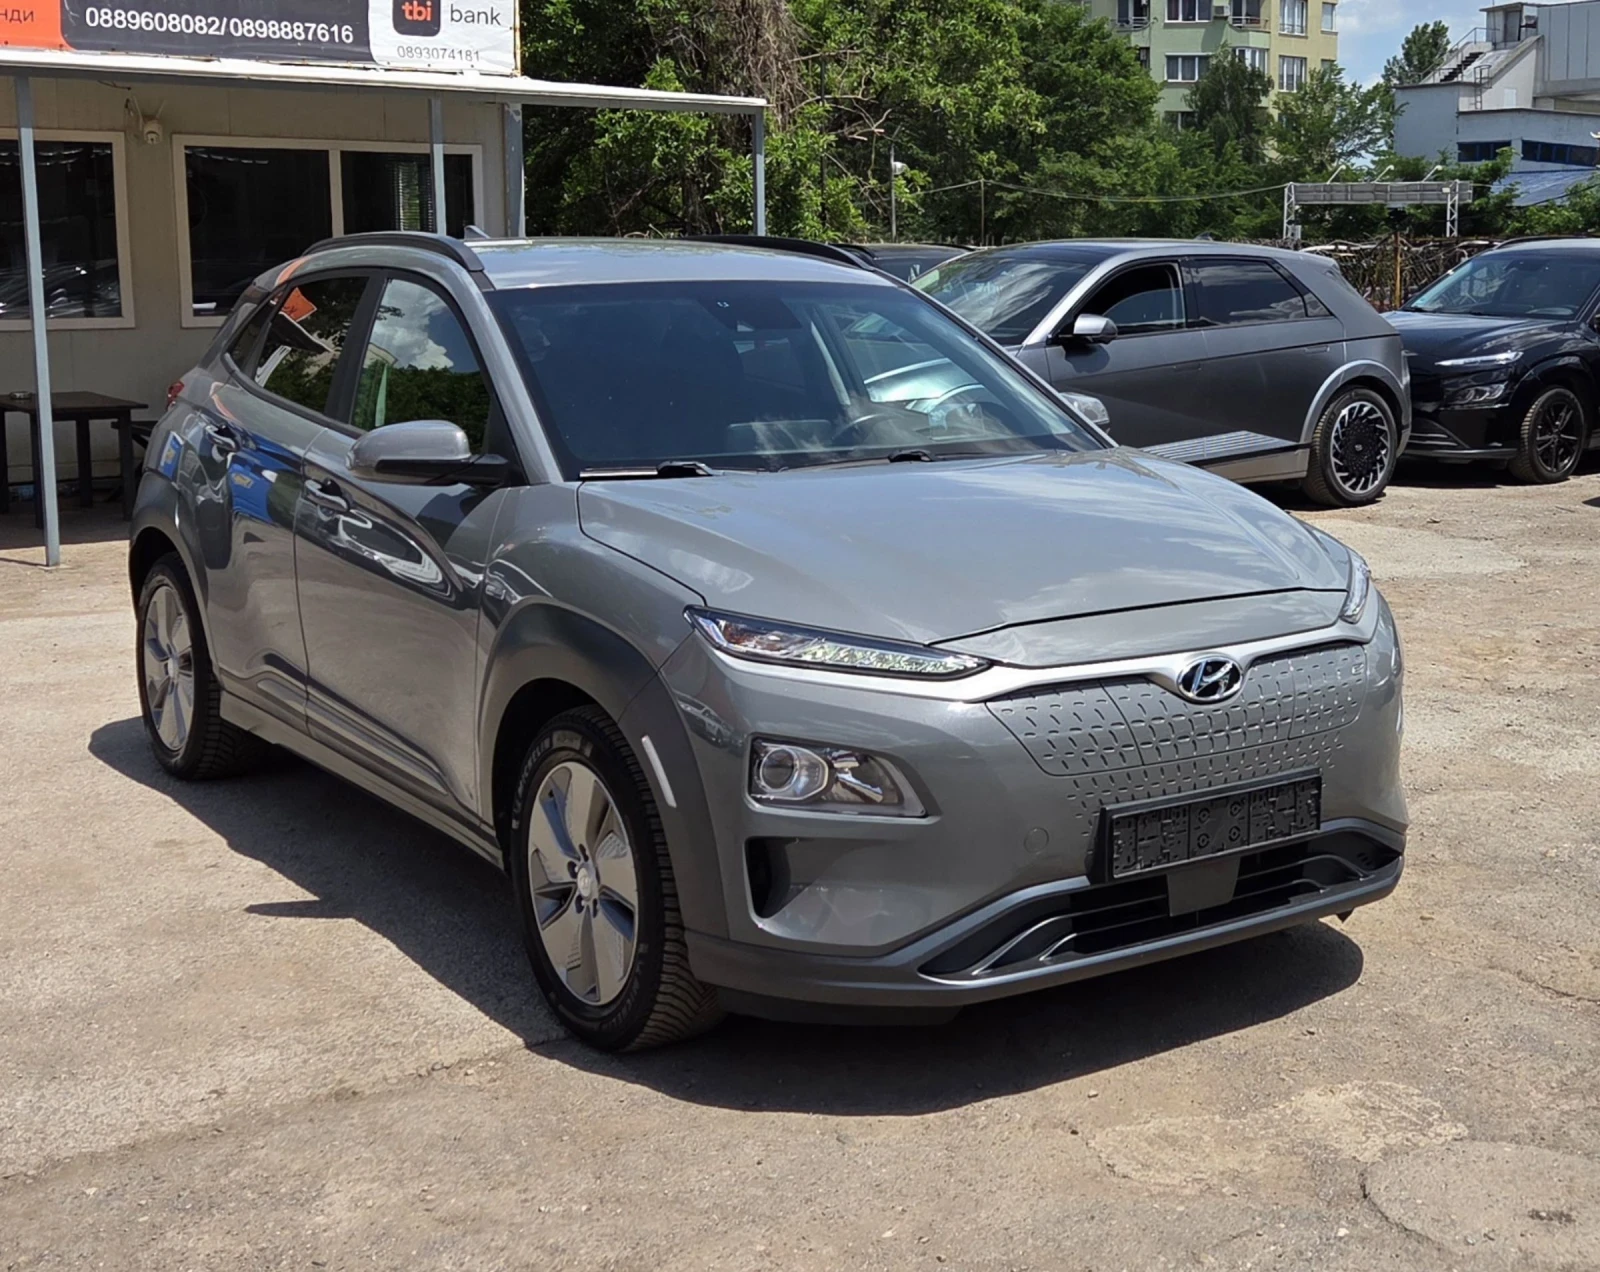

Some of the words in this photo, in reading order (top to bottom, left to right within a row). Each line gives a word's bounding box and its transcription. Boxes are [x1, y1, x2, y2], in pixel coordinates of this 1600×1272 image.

[85, 7, 354, 44] 0889608082/0898887616
[402, 0, 432, 21] tbi
[450, 4, 502, 26] bank
[397, 45, 480, 61] 0893074181
